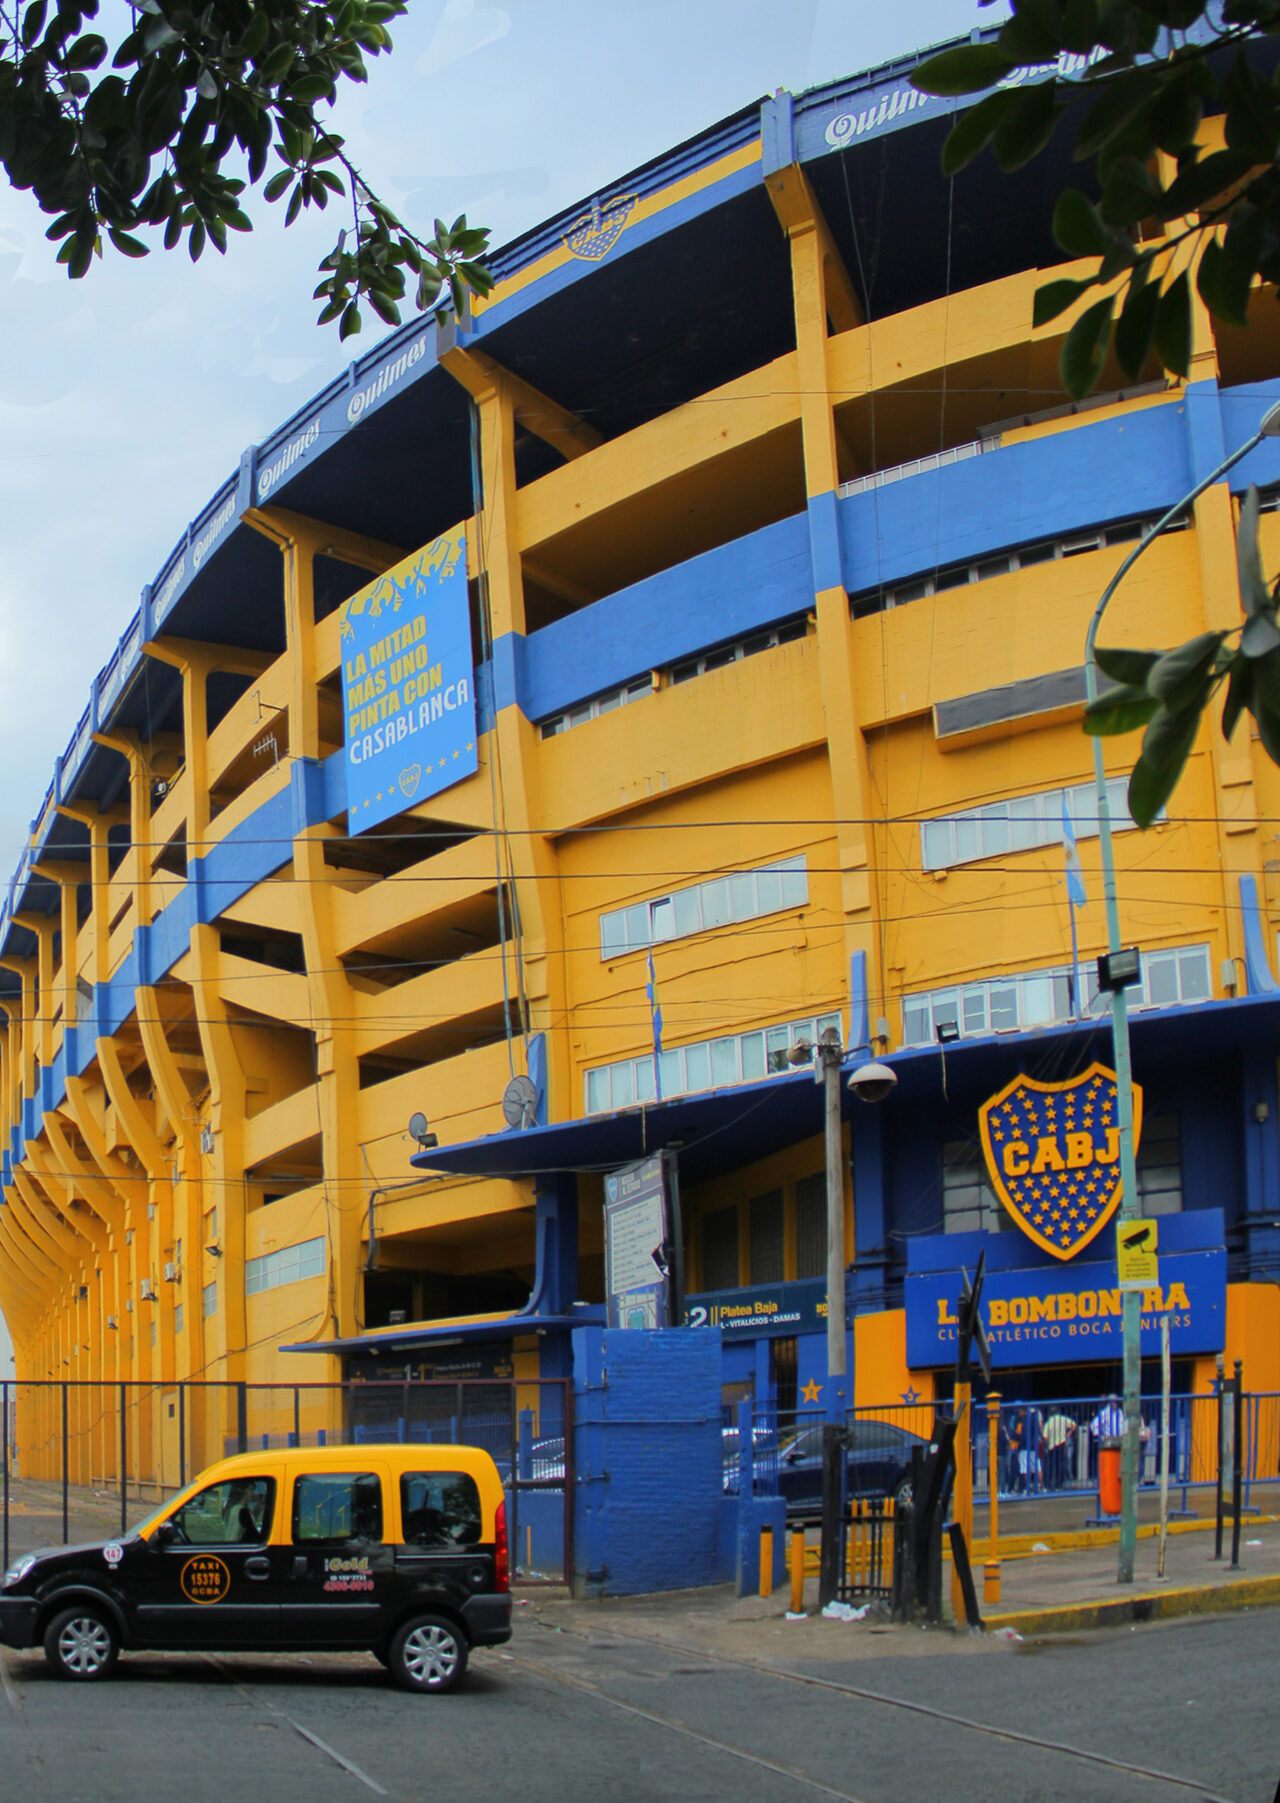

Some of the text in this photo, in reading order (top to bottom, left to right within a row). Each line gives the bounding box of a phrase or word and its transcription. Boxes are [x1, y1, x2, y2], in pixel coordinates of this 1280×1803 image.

[824, 87, 939, 152] Quilm
[347, 335, 426, 427] Quilmes
[258, 418, 321, 501] Quilmes
[193, 494, 236, 572] Quilmes
[346, 615, 427, 684] LA MITAD
[348, 643, 429, 712] MÁS UNO
[349, 662, 443, 739] PINTA CON
[349, 678, 469, 765] CASABLANCA
[1003, 1127, 1120, 1177] CABJ
[720, 1301, 778, 1318] Platea Baja
[729, 1315, 769, 1329] VITALICIOS
[773, 1312, 801, 1324] DAMAS
[987, 1325, 1061, 1343] ATLÉTICO
[1069, 1322, 1113, 1337] BOCA
[988, 1282, 1191, 1327] BOMBONRA
[191, 1573, 221, 1586] 15376
[192, 1562, 220, 1571] TAXI
[329, 1556, 369, 1572] Gold
